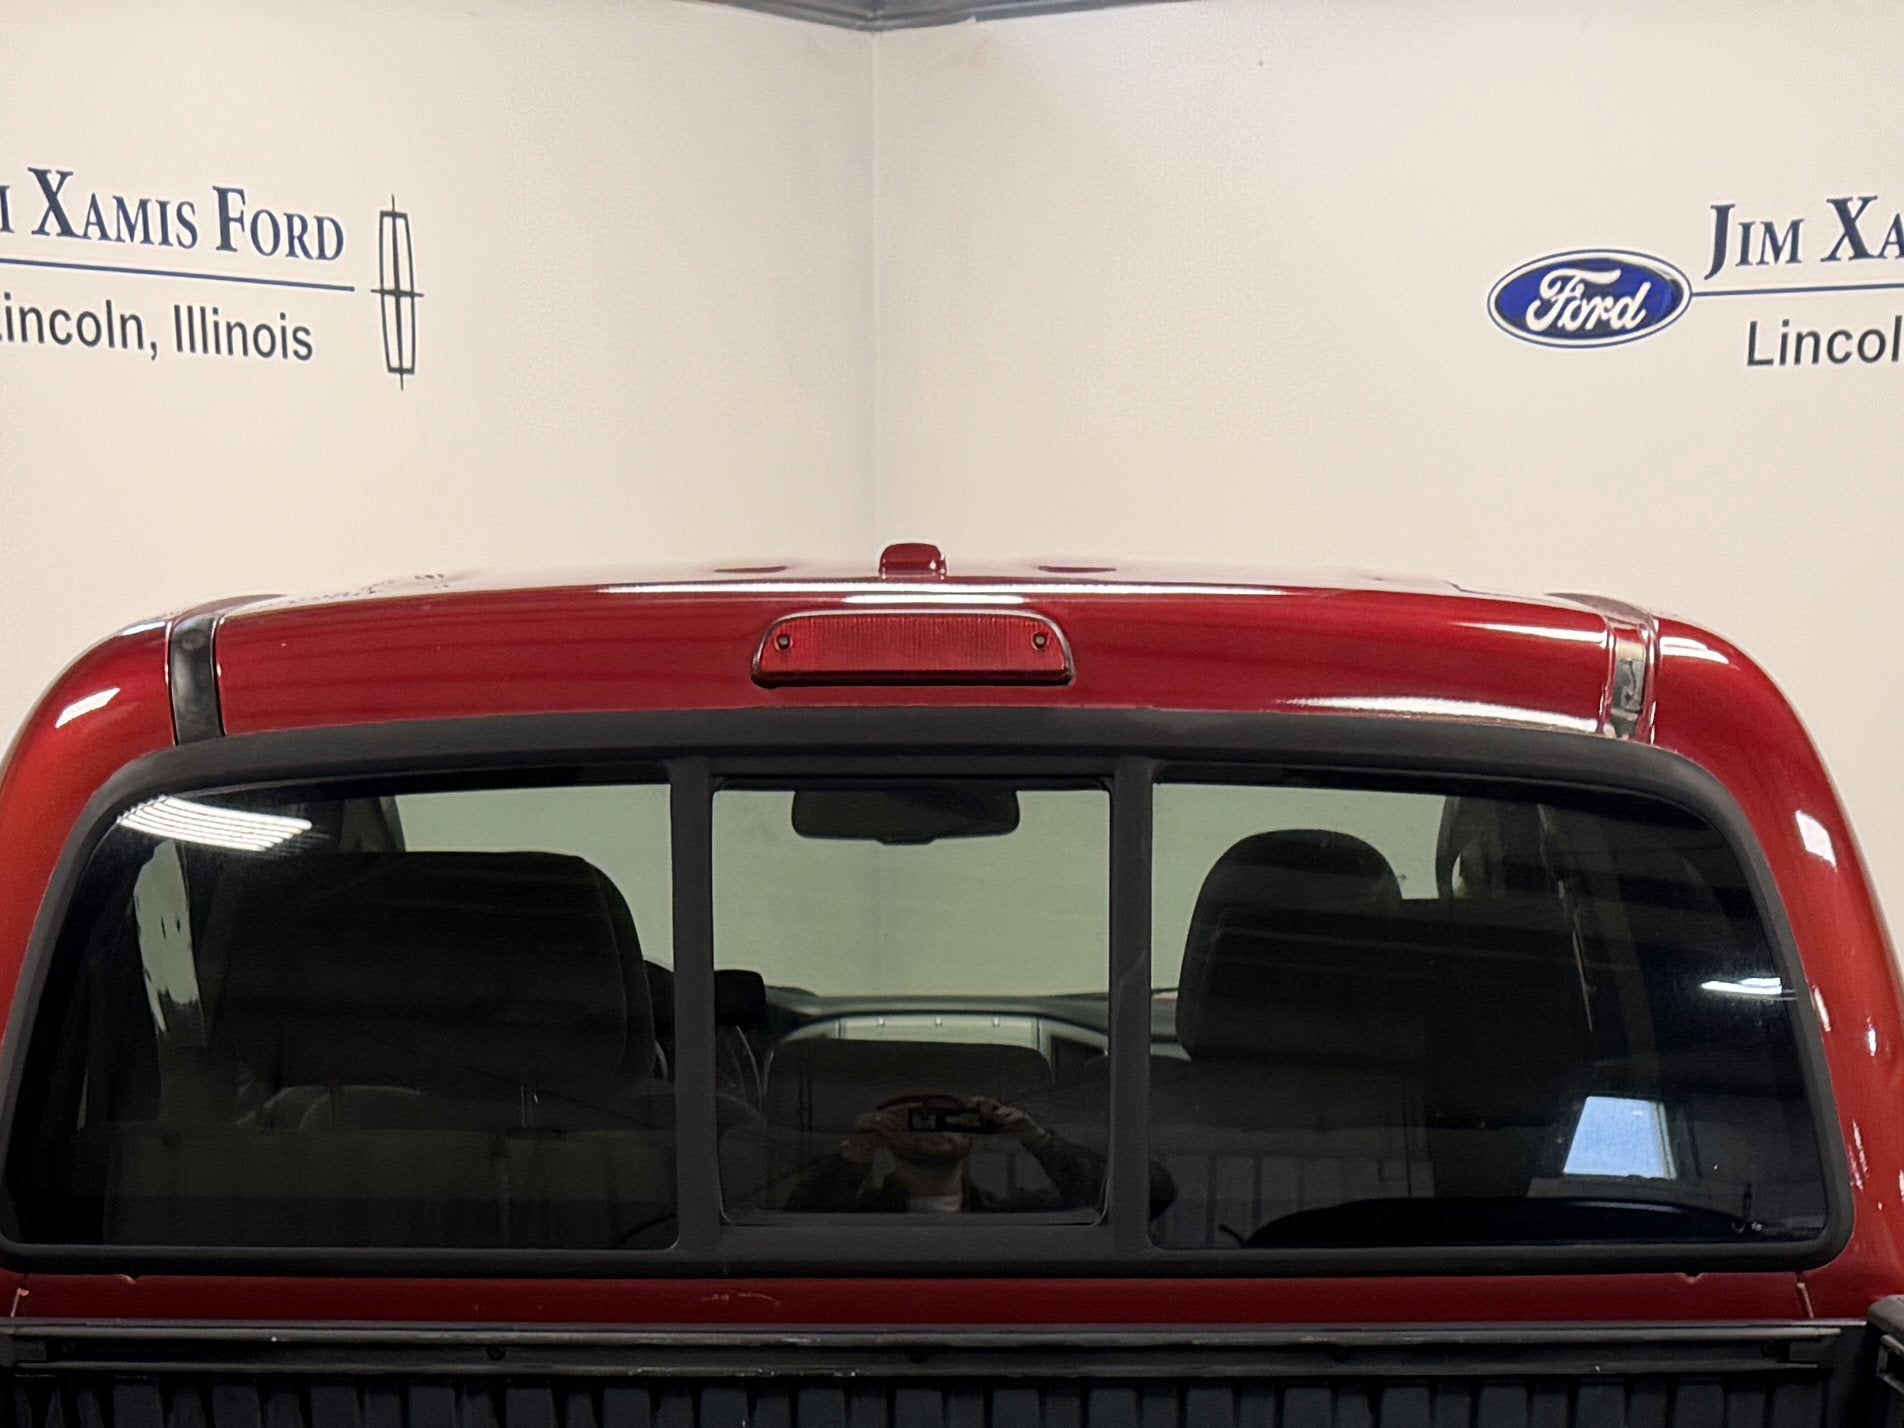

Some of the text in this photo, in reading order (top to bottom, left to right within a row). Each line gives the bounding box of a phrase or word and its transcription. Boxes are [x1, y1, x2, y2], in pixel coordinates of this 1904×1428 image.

[27, 167, 198, 249] XAMIS
[212, 186, 345, 261] FORD
[1703, 202, 1805, 281] JIM
[173, 293, 313, 361] Illinois
[1525, 267, 1652, 332] Ford
